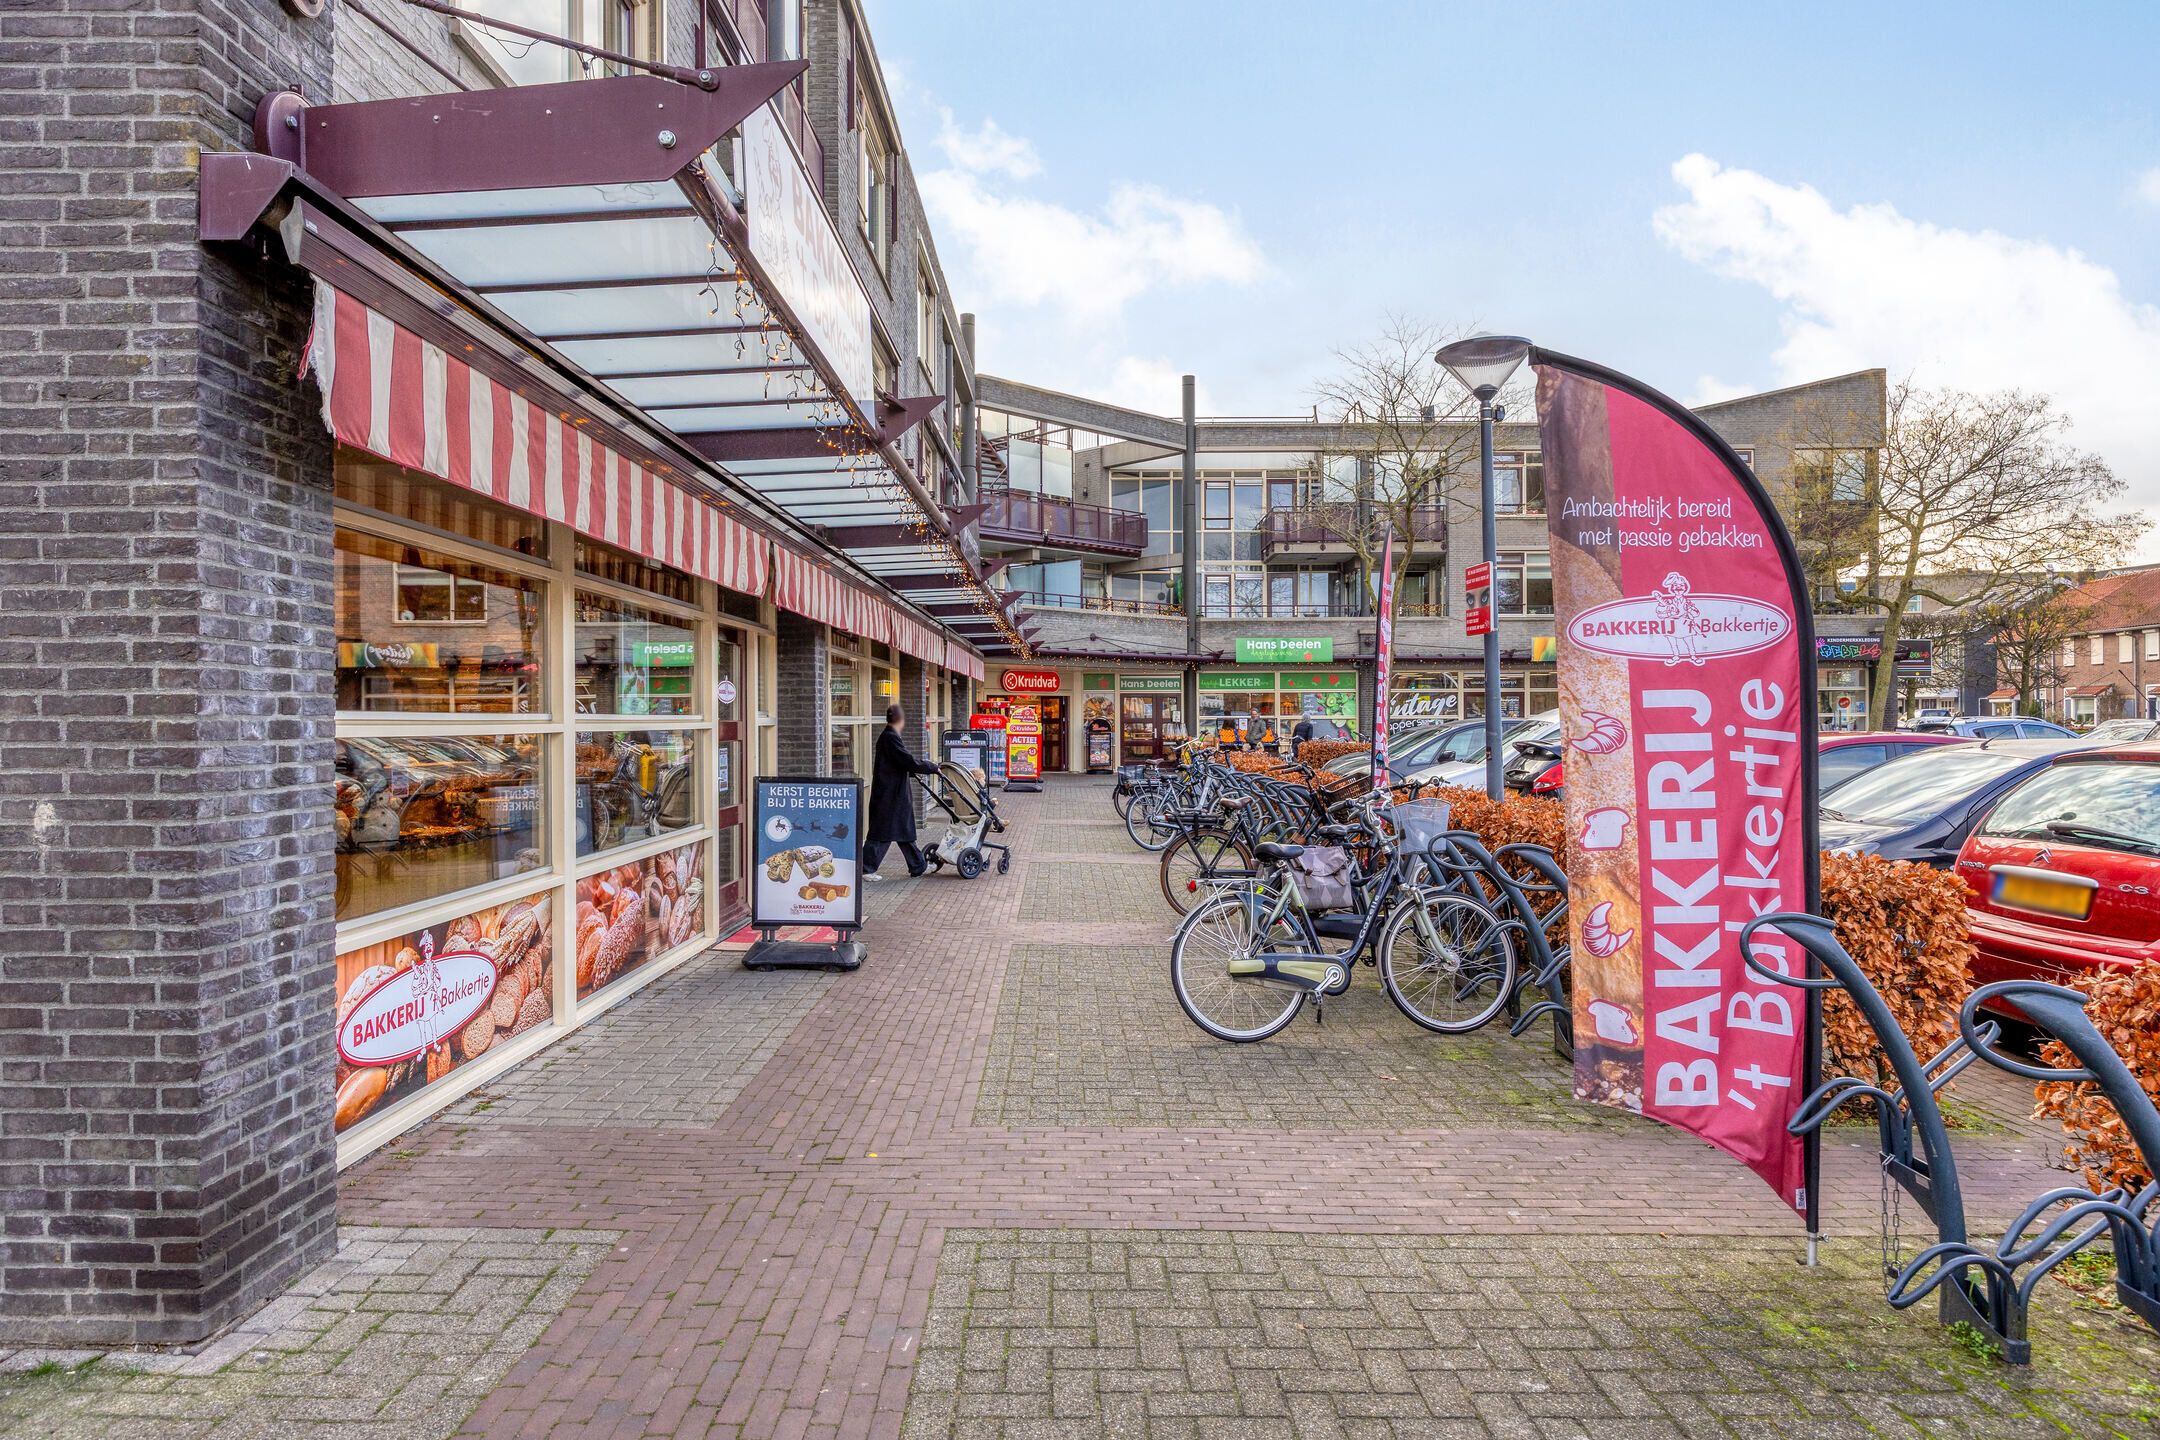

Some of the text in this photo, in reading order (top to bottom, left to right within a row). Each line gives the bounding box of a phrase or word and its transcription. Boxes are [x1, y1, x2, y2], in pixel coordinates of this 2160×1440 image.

[1562, 497, 1732, 525] Ambachtelijk bereid
[1579, 525, 1763, 552] met passie gebakken
[1582, 619, 1676, 637] BAKKERIJ
[1701, 617, 1779, 635] Bakkertje
[1247, 639, 1322, 649] Hans Deelen
[1018, 675, 1057, 688] Kruidvat
[1121, 680, 1180, 688] Hans Deelen
[1220, 678, 1261, 687] LEKKER
[770, 786, 848, 797] KERST BEGINT
[767, 798, 850, 809] BIJ DE BAKKER
[1724, 678, 1797, 1037] Bakkertje
[1642, 688, 1722, 1107] BAKKERIJ
[1359, 894, 1380, 939] Gazelle
[353, 997, 425, 1047] BAKKERIJ
[440, 973, 490, 1008] Bakkertje
